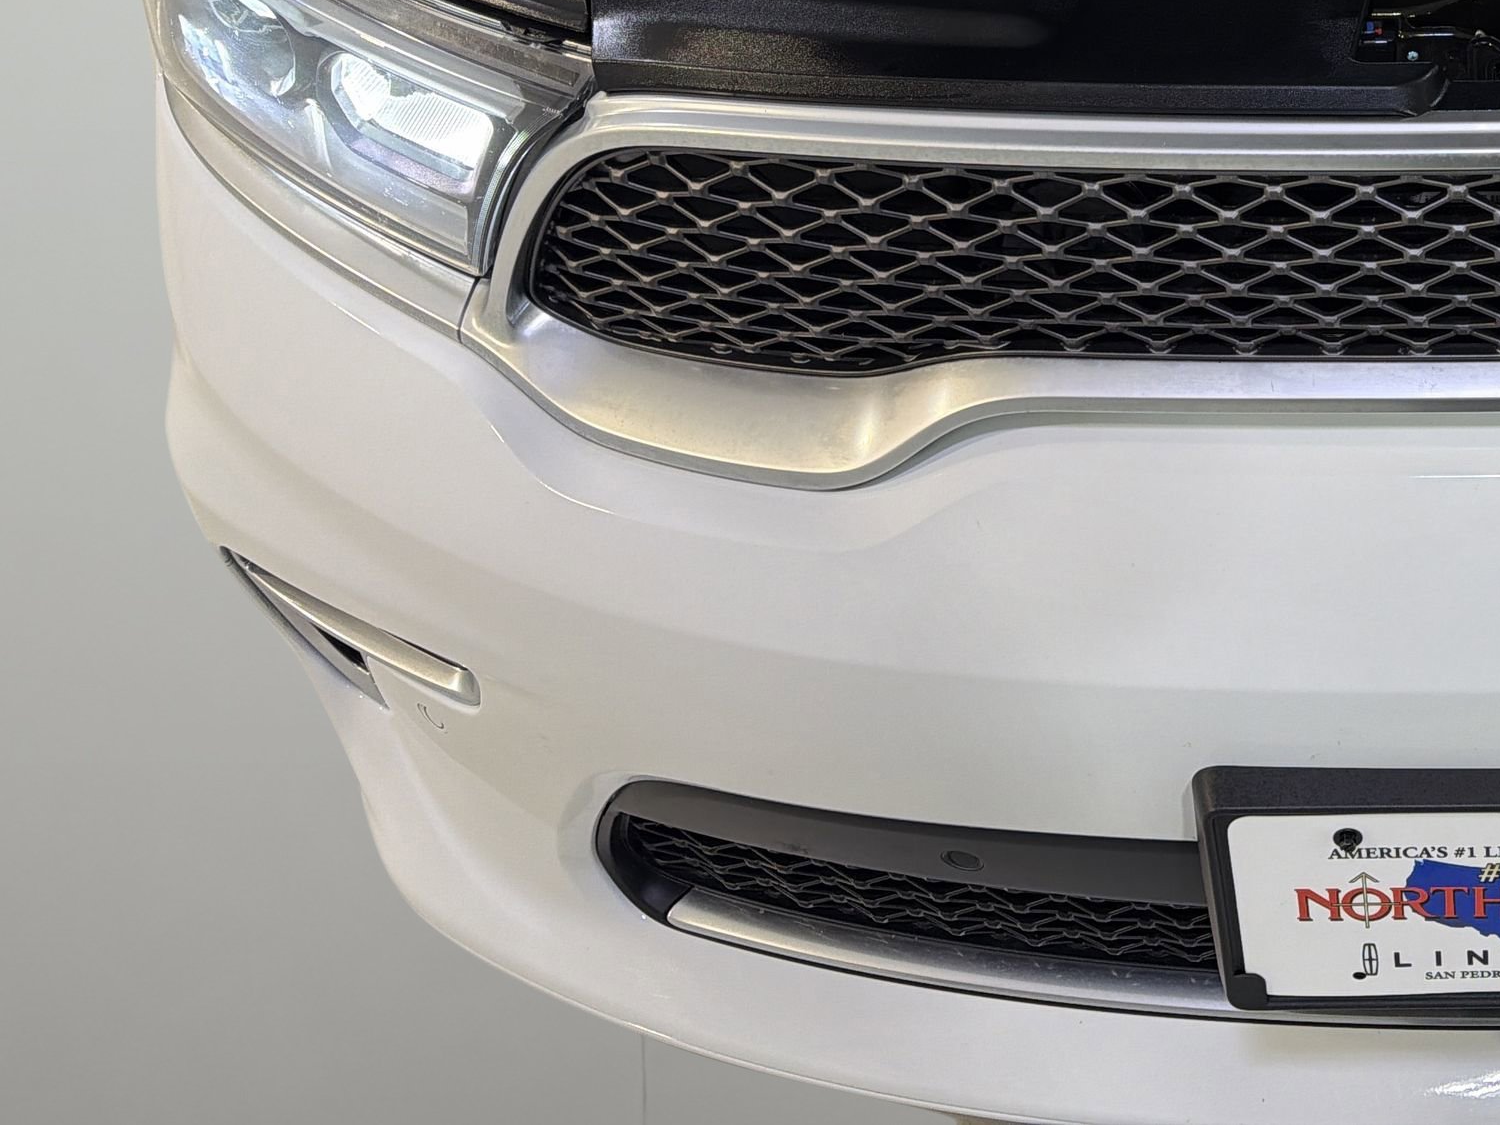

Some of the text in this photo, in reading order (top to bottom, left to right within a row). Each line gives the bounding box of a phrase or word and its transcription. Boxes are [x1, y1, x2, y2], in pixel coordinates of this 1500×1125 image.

[1328, 846, 1448, 860] AMERICA'S
[1454, 846, 1477, 859] #1
[1425, 971, 1456, 980] SAN
